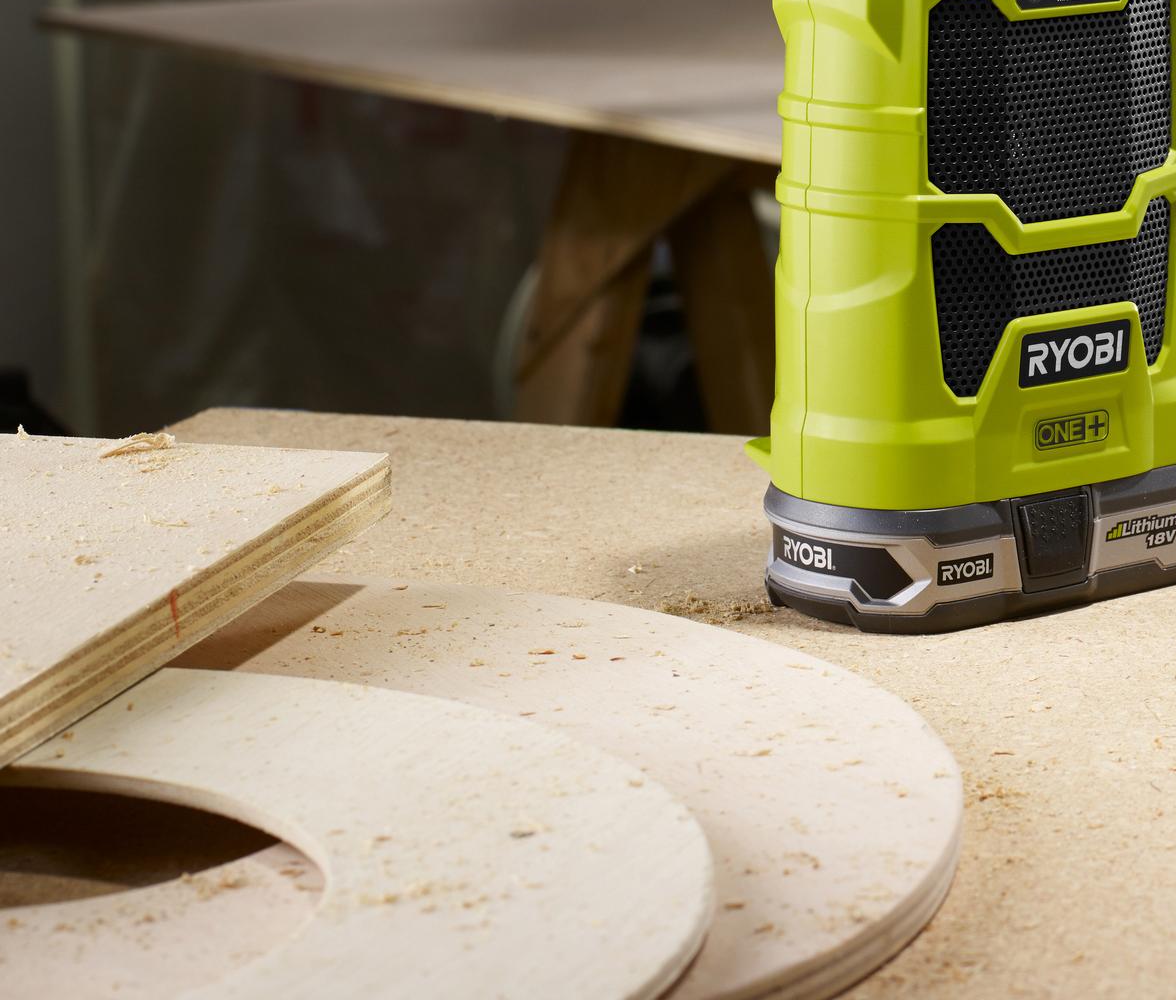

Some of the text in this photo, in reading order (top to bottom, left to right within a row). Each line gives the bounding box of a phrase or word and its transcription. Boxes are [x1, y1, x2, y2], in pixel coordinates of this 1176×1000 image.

[1028, 330, 1124, 377] RYOBI
[783, 535, 833, 571] RYOBI
[1146, 529, 1176, 547] 18V
[941, 558, 991, 582] RYOBI
